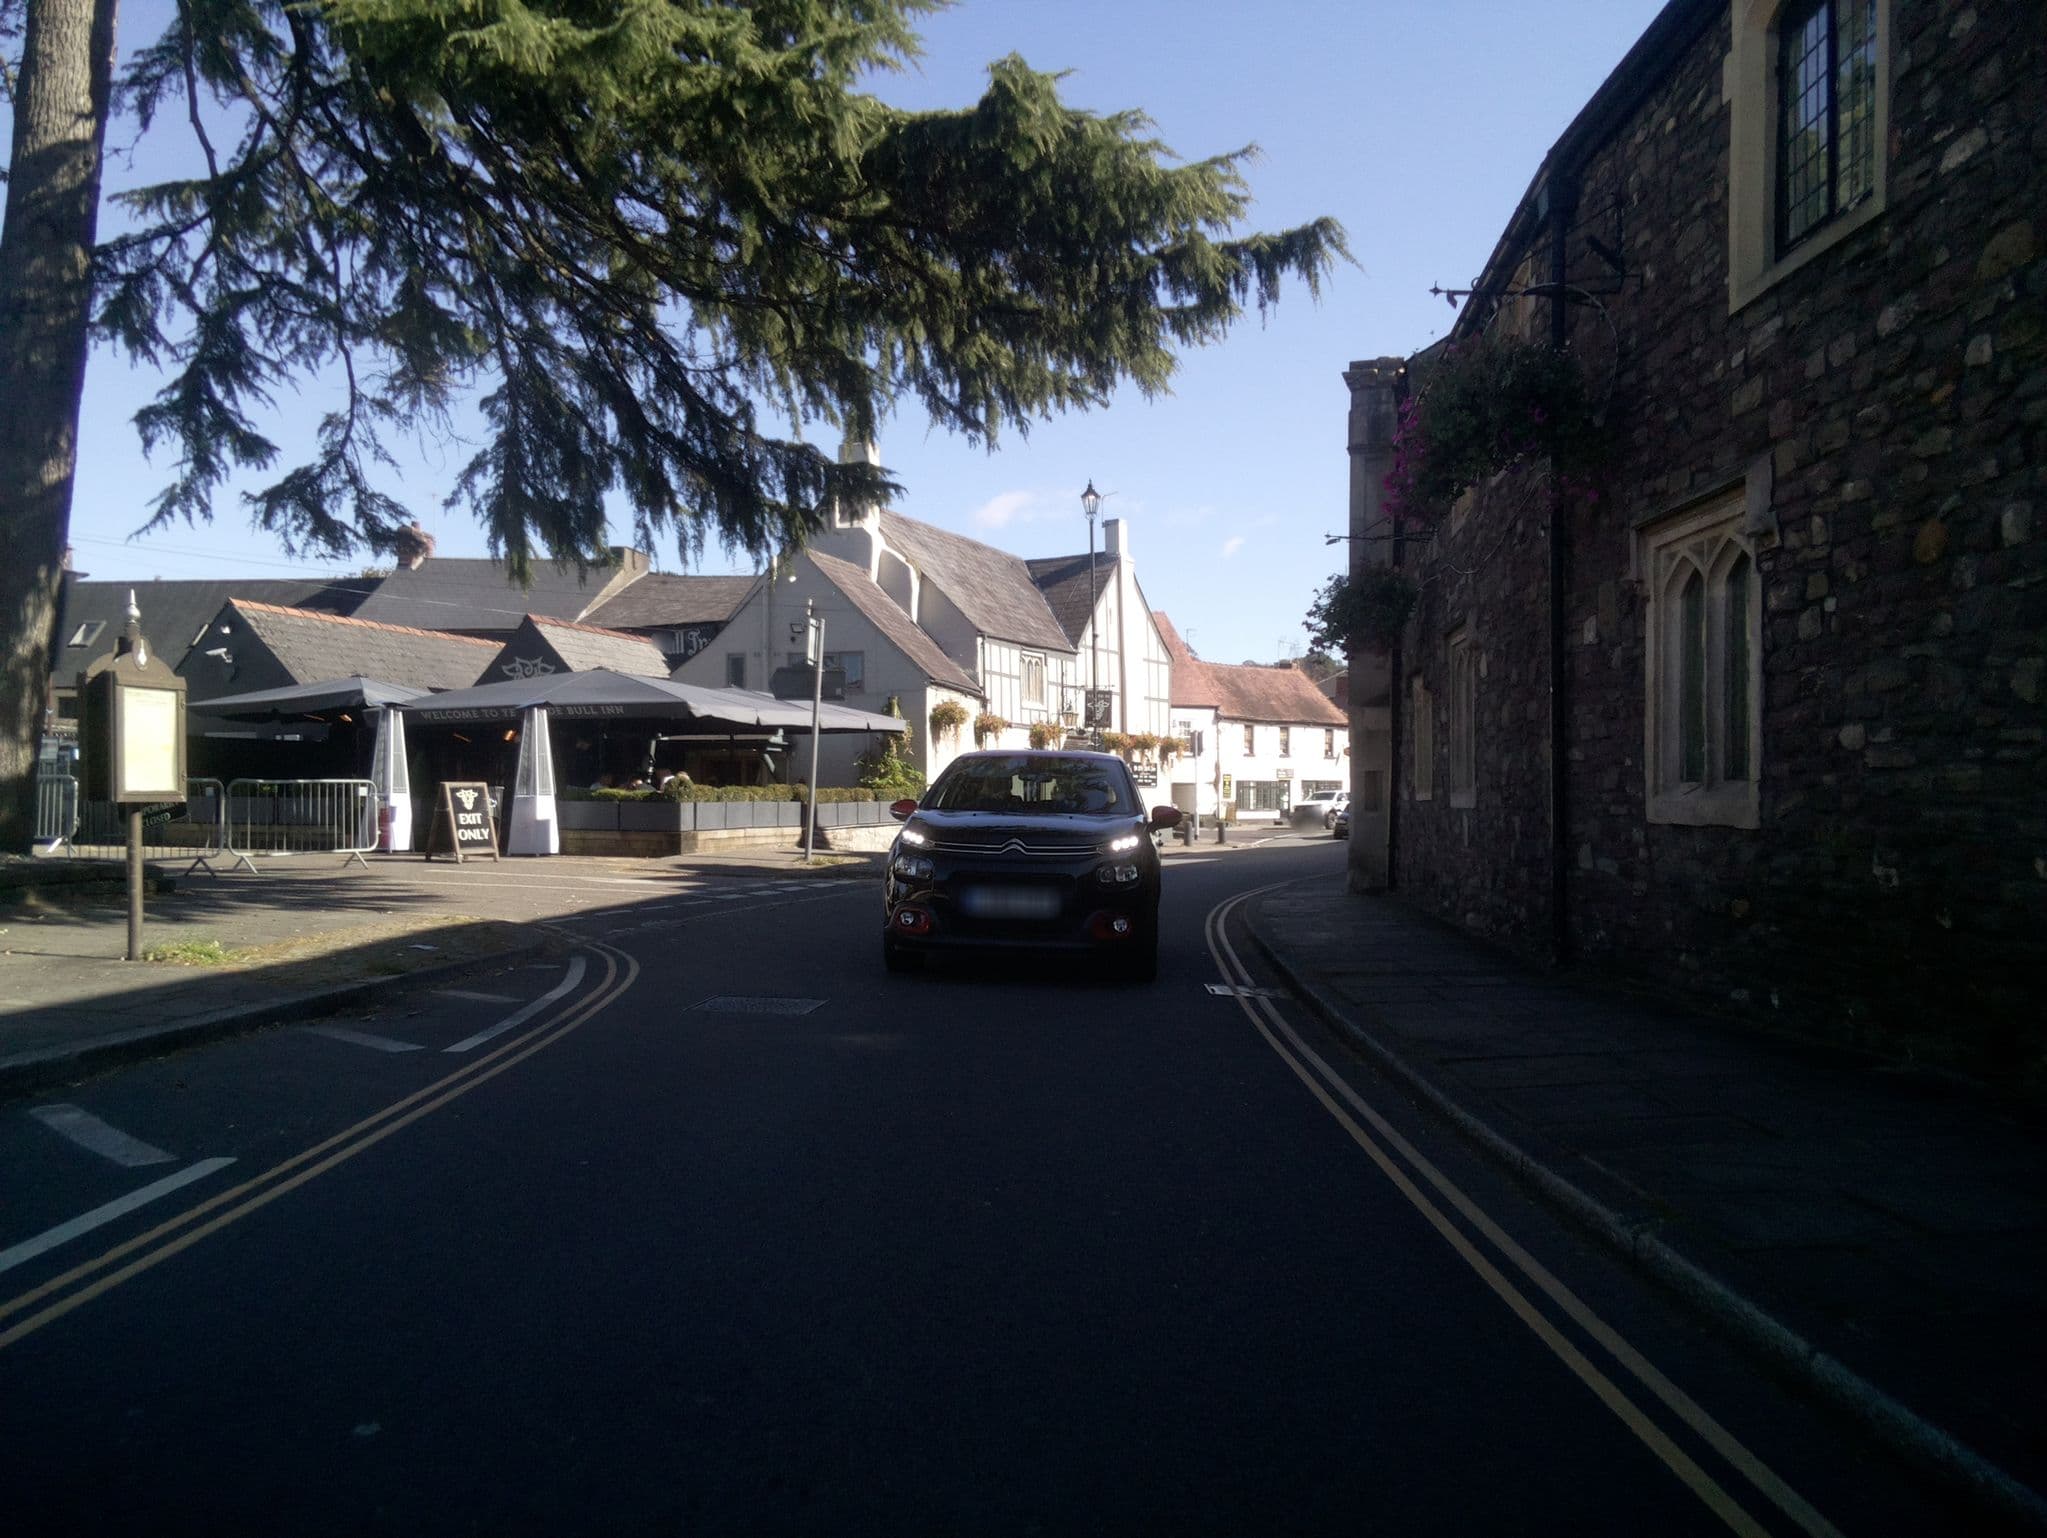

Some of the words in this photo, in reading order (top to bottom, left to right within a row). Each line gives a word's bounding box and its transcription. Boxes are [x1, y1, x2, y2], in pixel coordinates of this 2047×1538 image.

[420, 709, 480, 720] WELCOME
[481, 709, 498, 718] TO
[567, 705, 598, 715] BULL
[601, 705, 625, 714] INN
[458, 812, 482, 825] EXIT
[458, 828, 489, 841] ONLY
